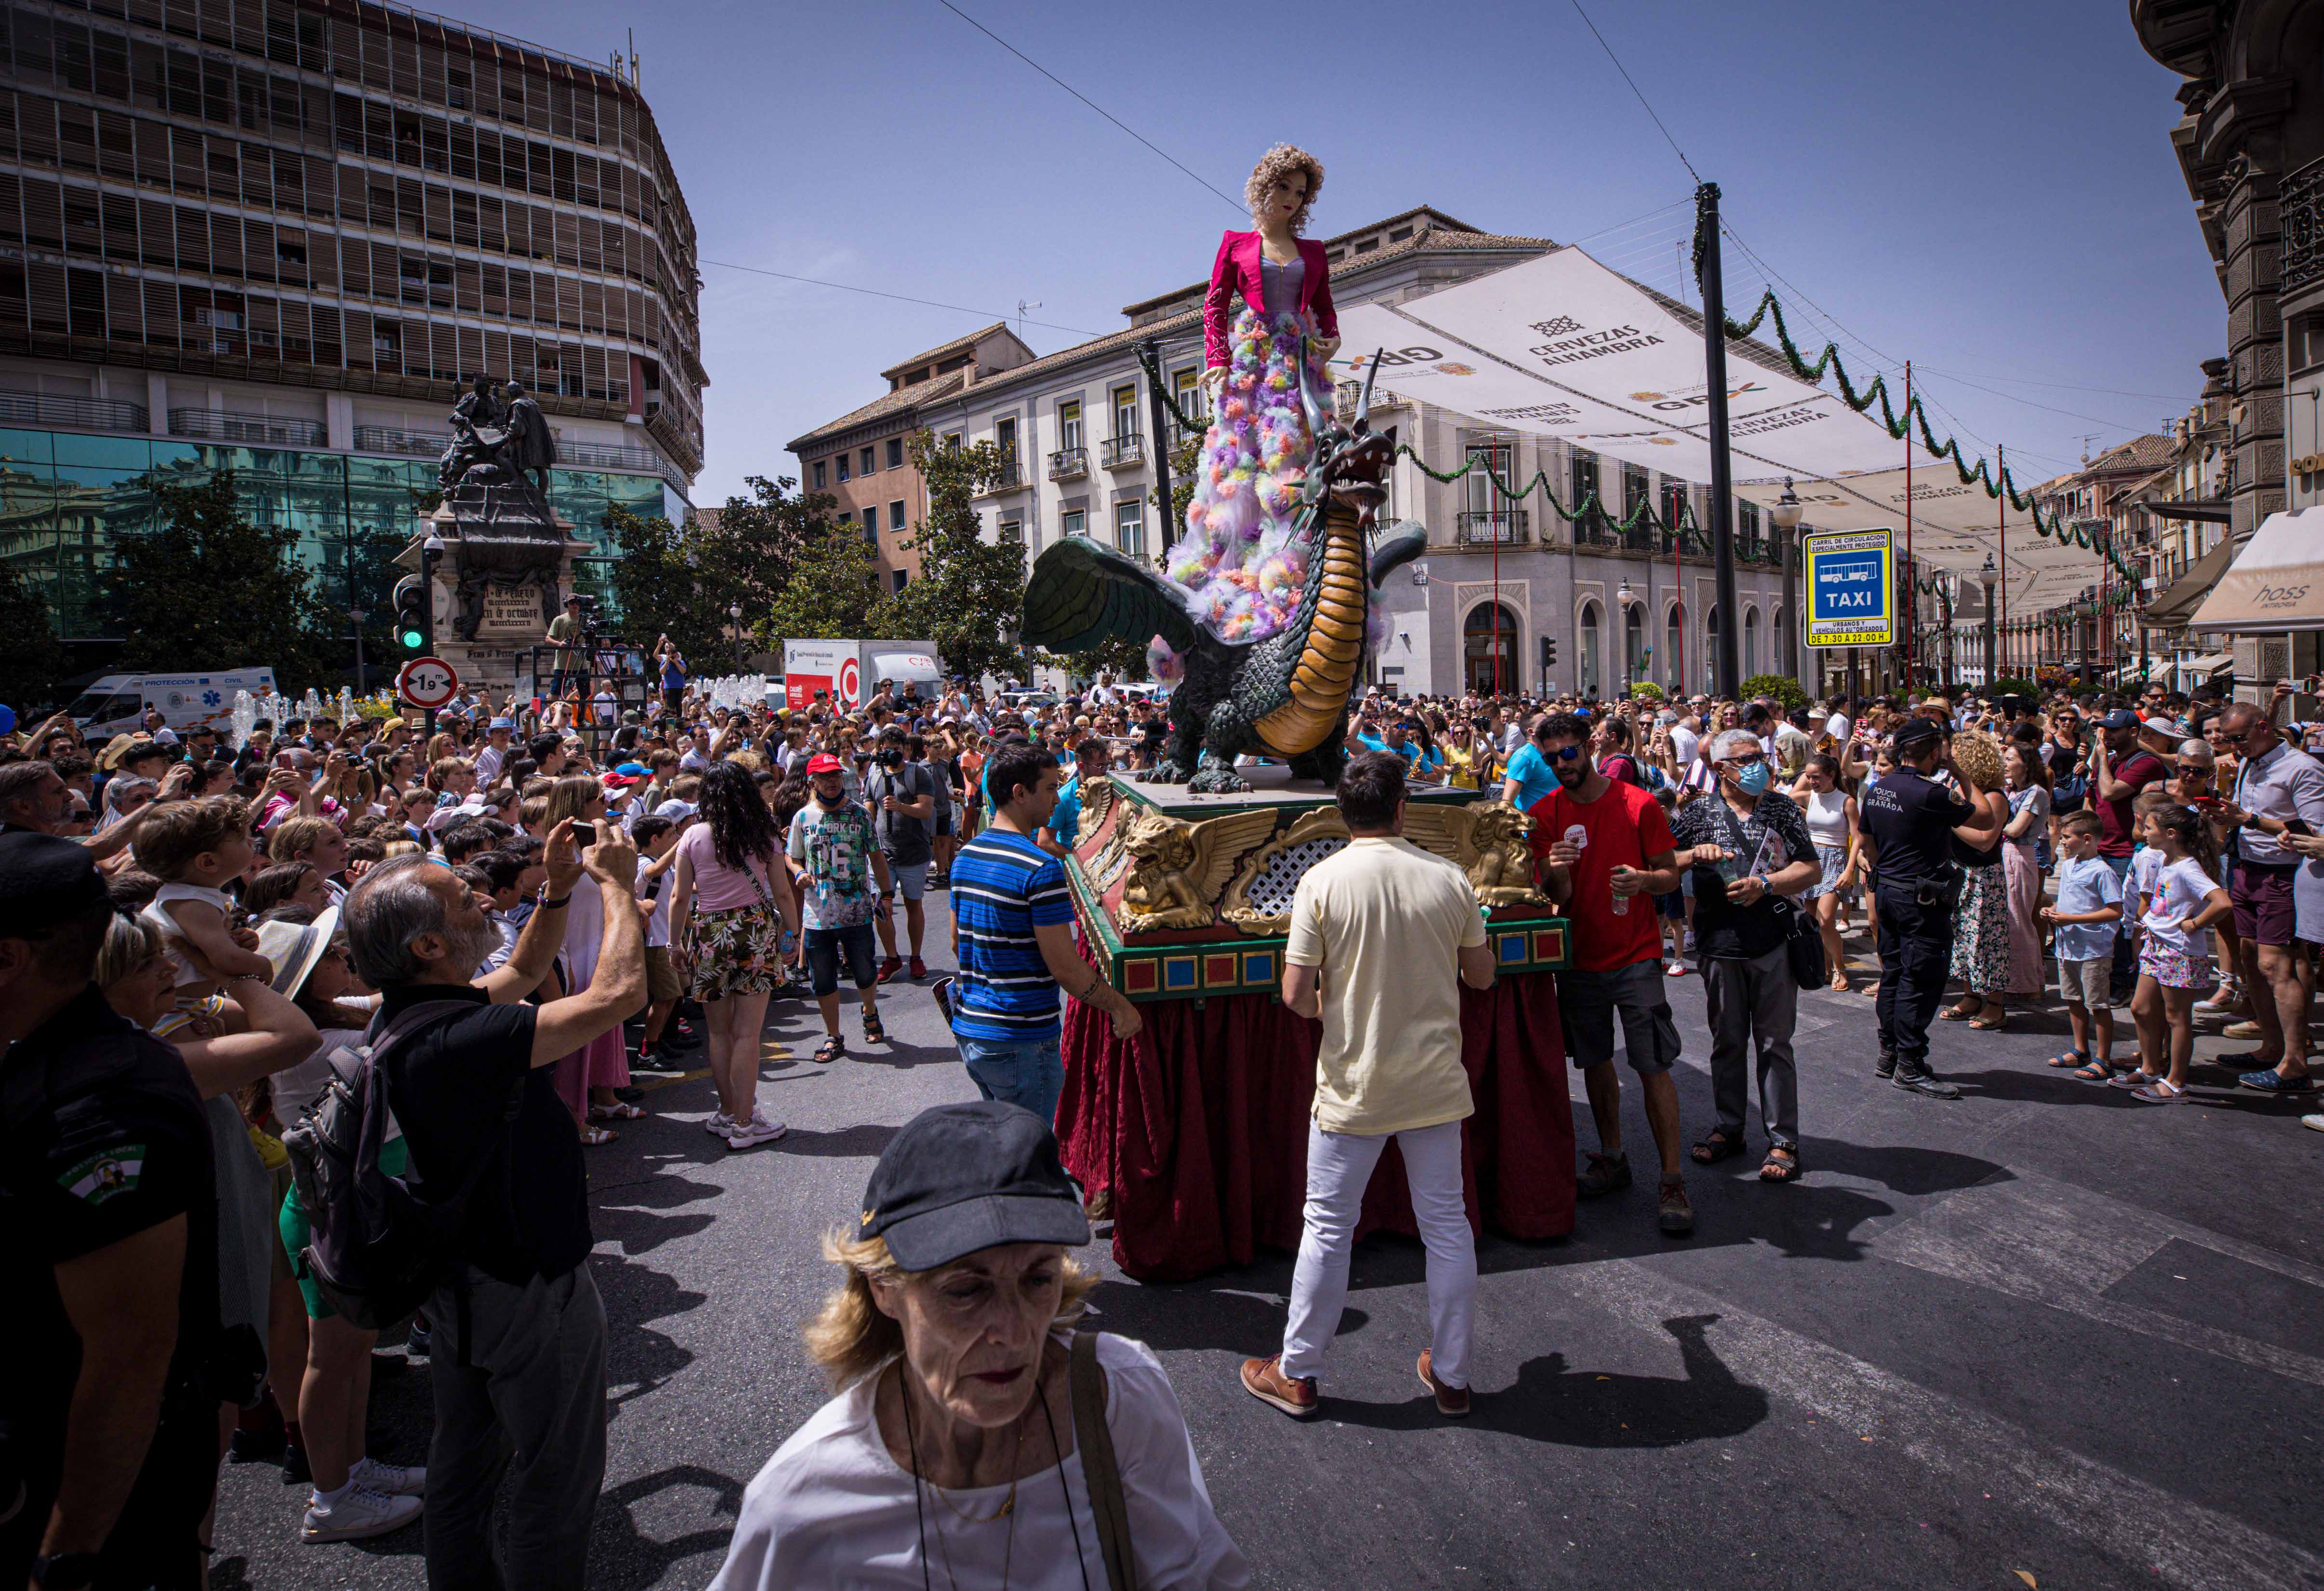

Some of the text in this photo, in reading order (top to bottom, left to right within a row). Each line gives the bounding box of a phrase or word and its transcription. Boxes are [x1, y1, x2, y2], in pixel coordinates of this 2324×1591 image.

[1529, 324, 1640, 356] CERVEZAS
[1542, 335, 1665, 366] ALHAMBRA
[1475, 403, 1571, 415] ALHAMBRA
[1495, 409, 1581, 419] CERVEZAS
[1730, 413, 1830, 438] ALHAMBRA
[1844, 534, 1885, 543] CIRCULACION
[1813, 544, 1853, 552] ESPECIALMENTE
[1826, 592, 1871, 607] TAXI
[2253, 584, 2311, 602] hoss
[1853, 634, 1876, 642] 22:00
[1867, 799, 1904, 813] GRANADA
[801, 825, 817, 836] NEW
